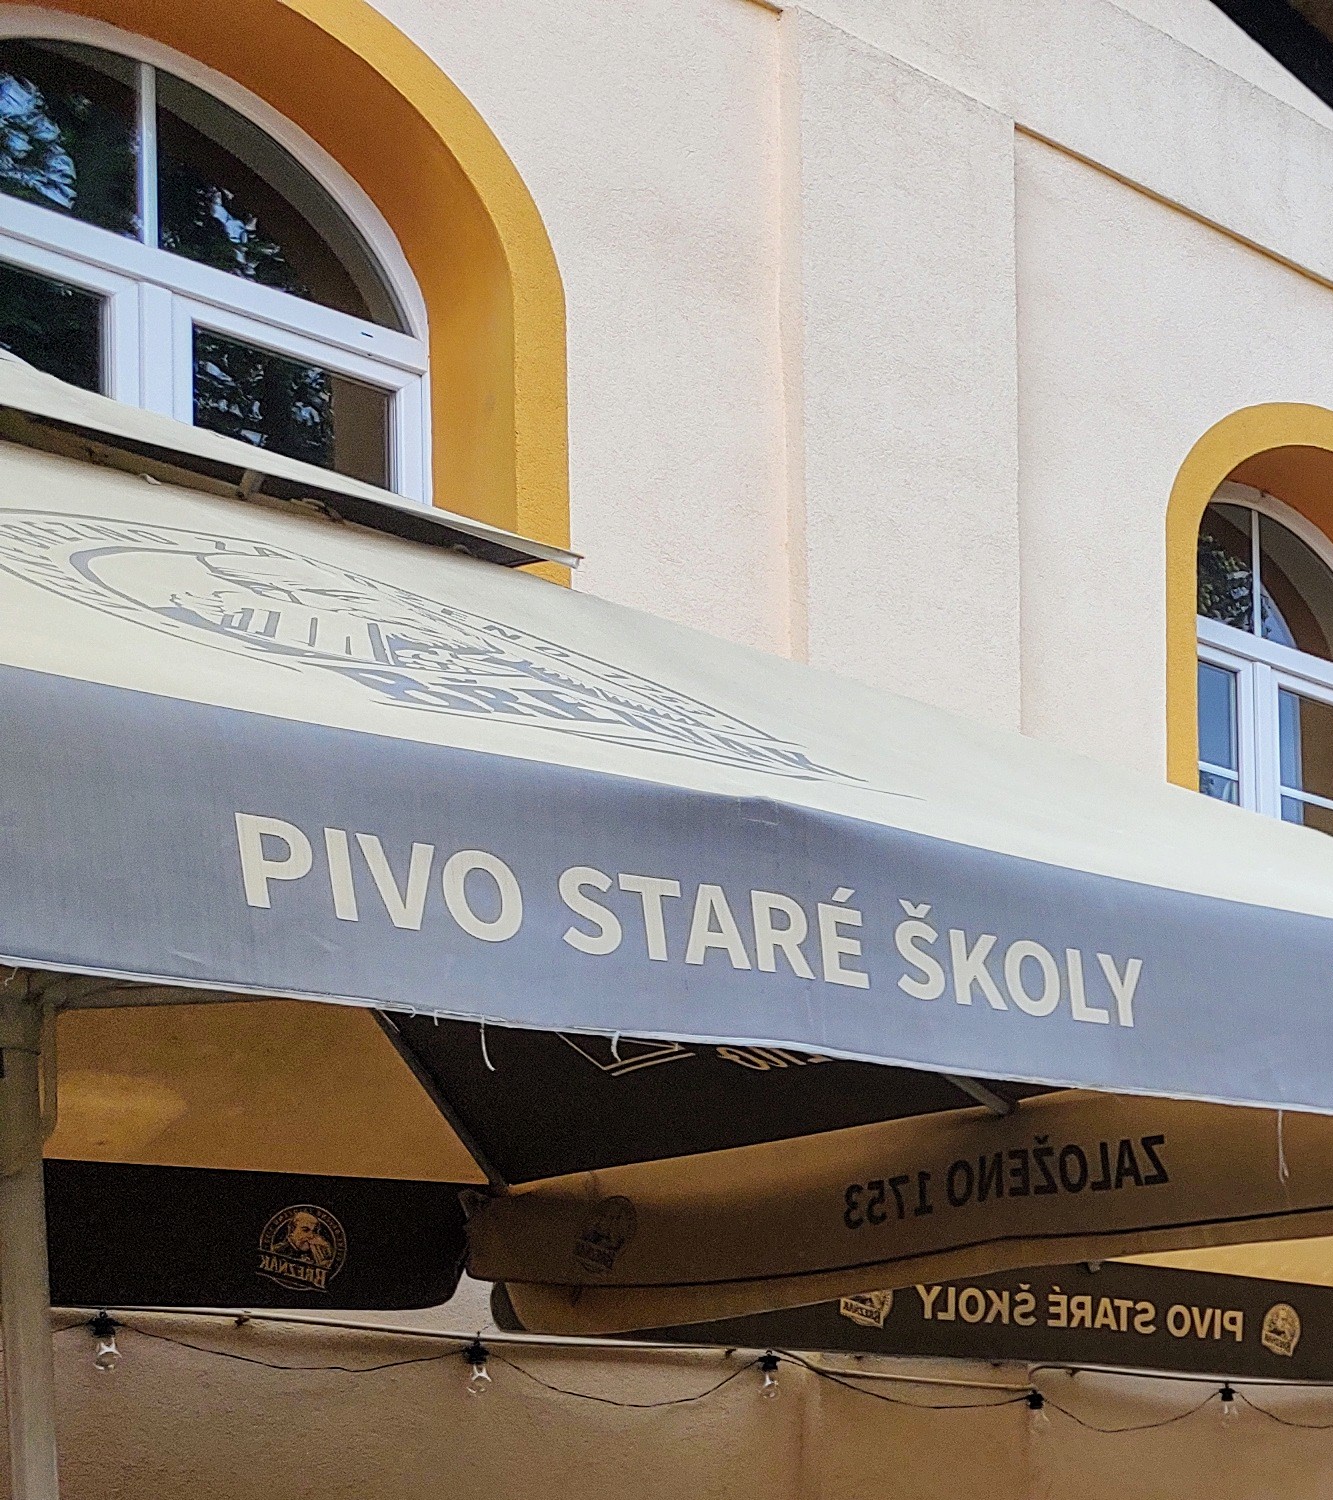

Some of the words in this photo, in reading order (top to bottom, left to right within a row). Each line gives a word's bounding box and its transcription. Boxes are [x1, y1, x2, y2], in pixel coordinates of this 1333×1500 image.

[234, 812, 523, 942] PIVO
[558, 866, 870, 989] STARÉ
[895, 898, 1143, 1028] ŠKOLY
